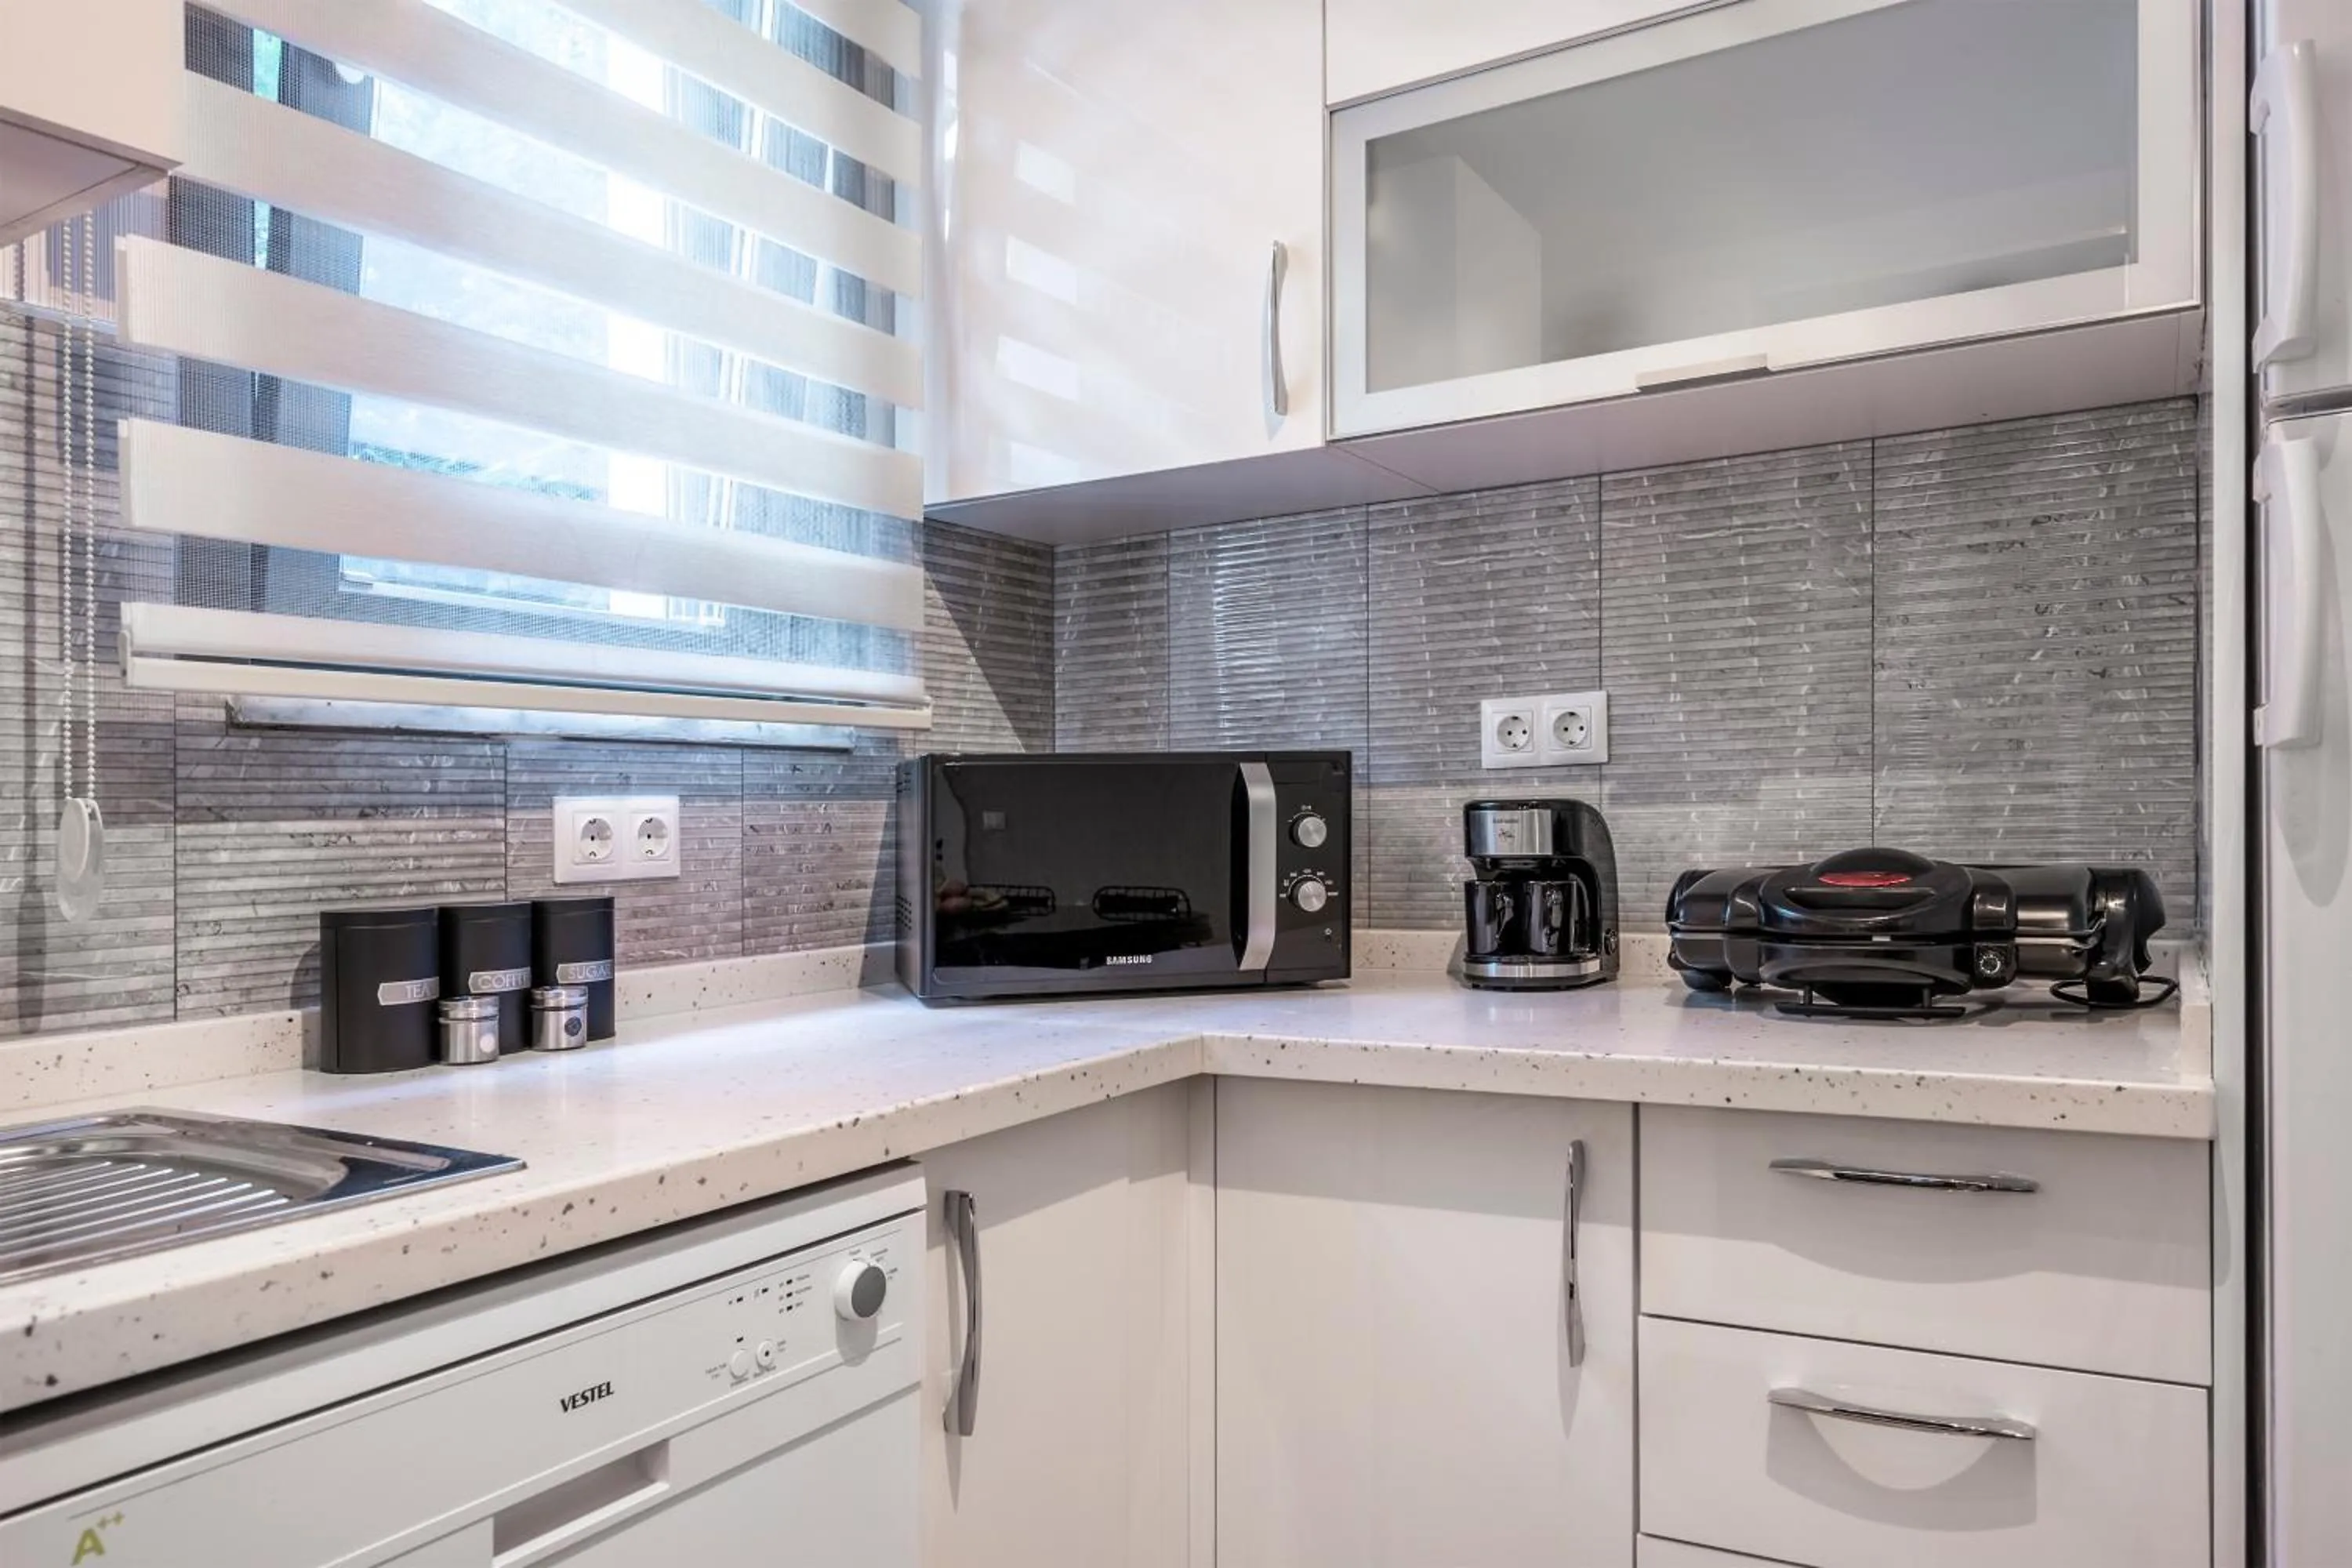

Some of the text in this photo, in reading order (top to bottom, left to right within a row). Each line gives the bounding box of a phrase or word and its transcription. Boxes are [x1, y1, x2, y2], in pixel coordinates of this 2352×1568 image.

[1106, 955, 1152, 965] SAMSUNG
[405, 982, 431, 1000] TEA
[561, 1381, 615, 1413] VESTEL
